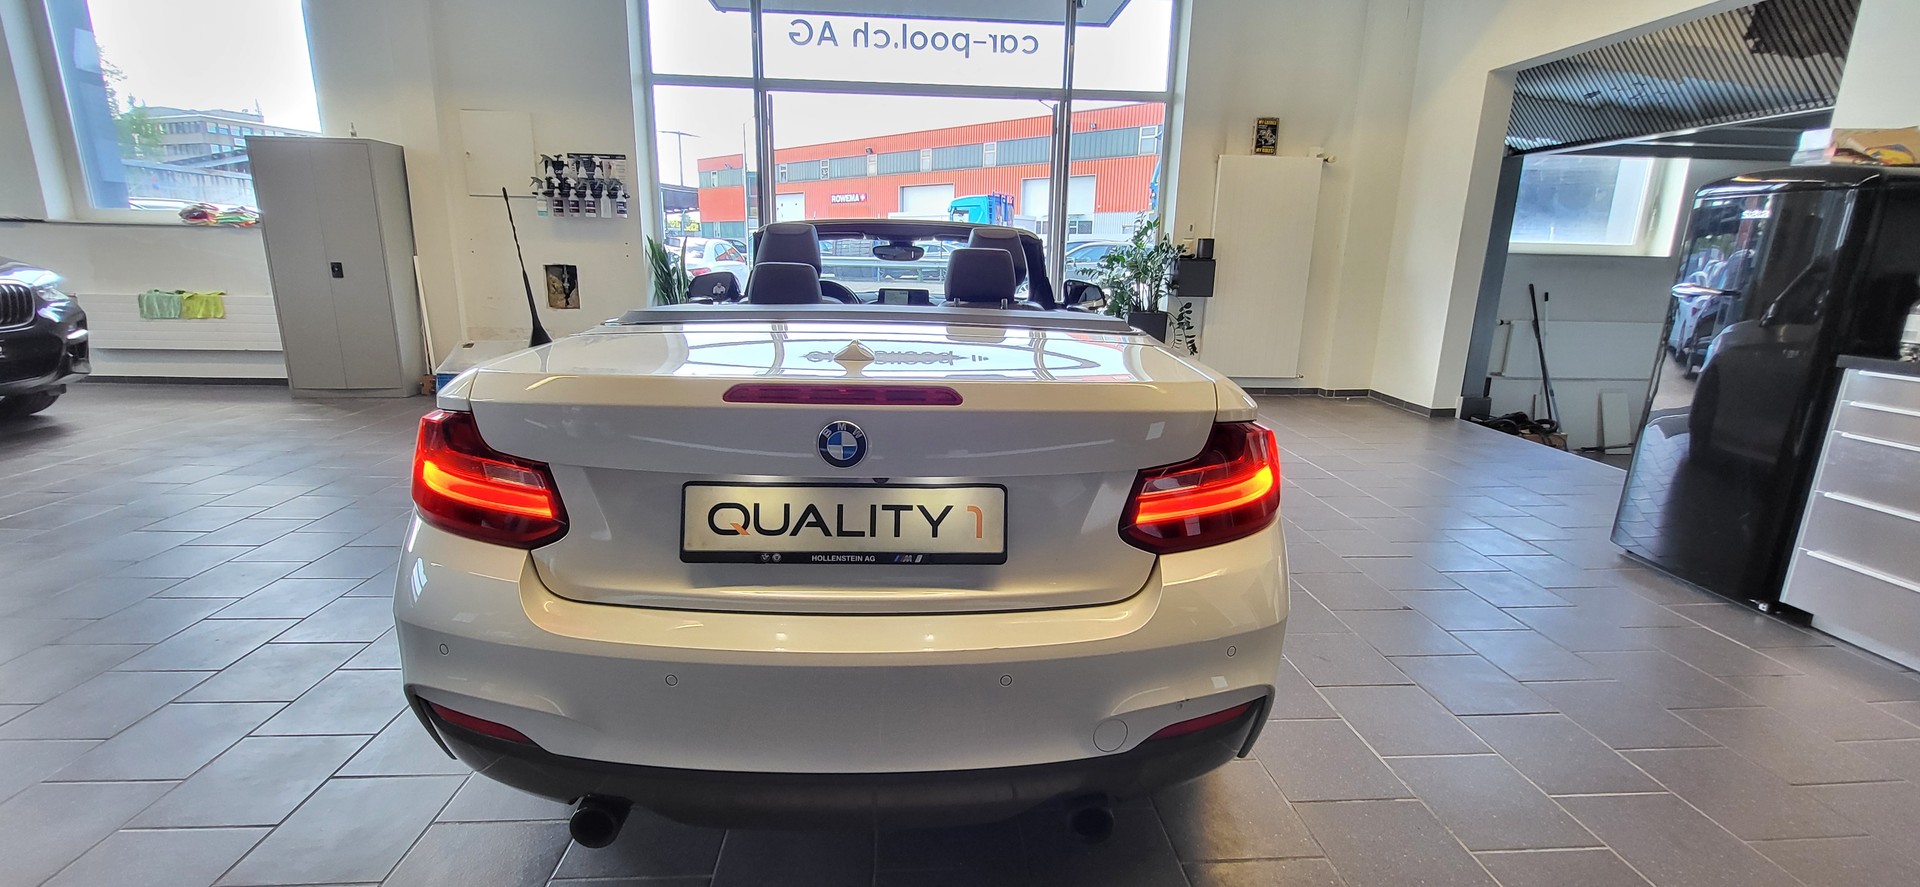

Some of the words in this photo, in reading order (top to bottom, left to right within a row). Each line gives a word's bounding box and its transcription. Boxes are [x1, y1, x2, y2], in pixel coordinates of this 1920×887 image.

[831, 193, 860, 203] ROWEMA
[822, 422, 862, 439] BMW
[707, 502, 954, 538] QUALITY
[967, 505, 983, 539] 1
